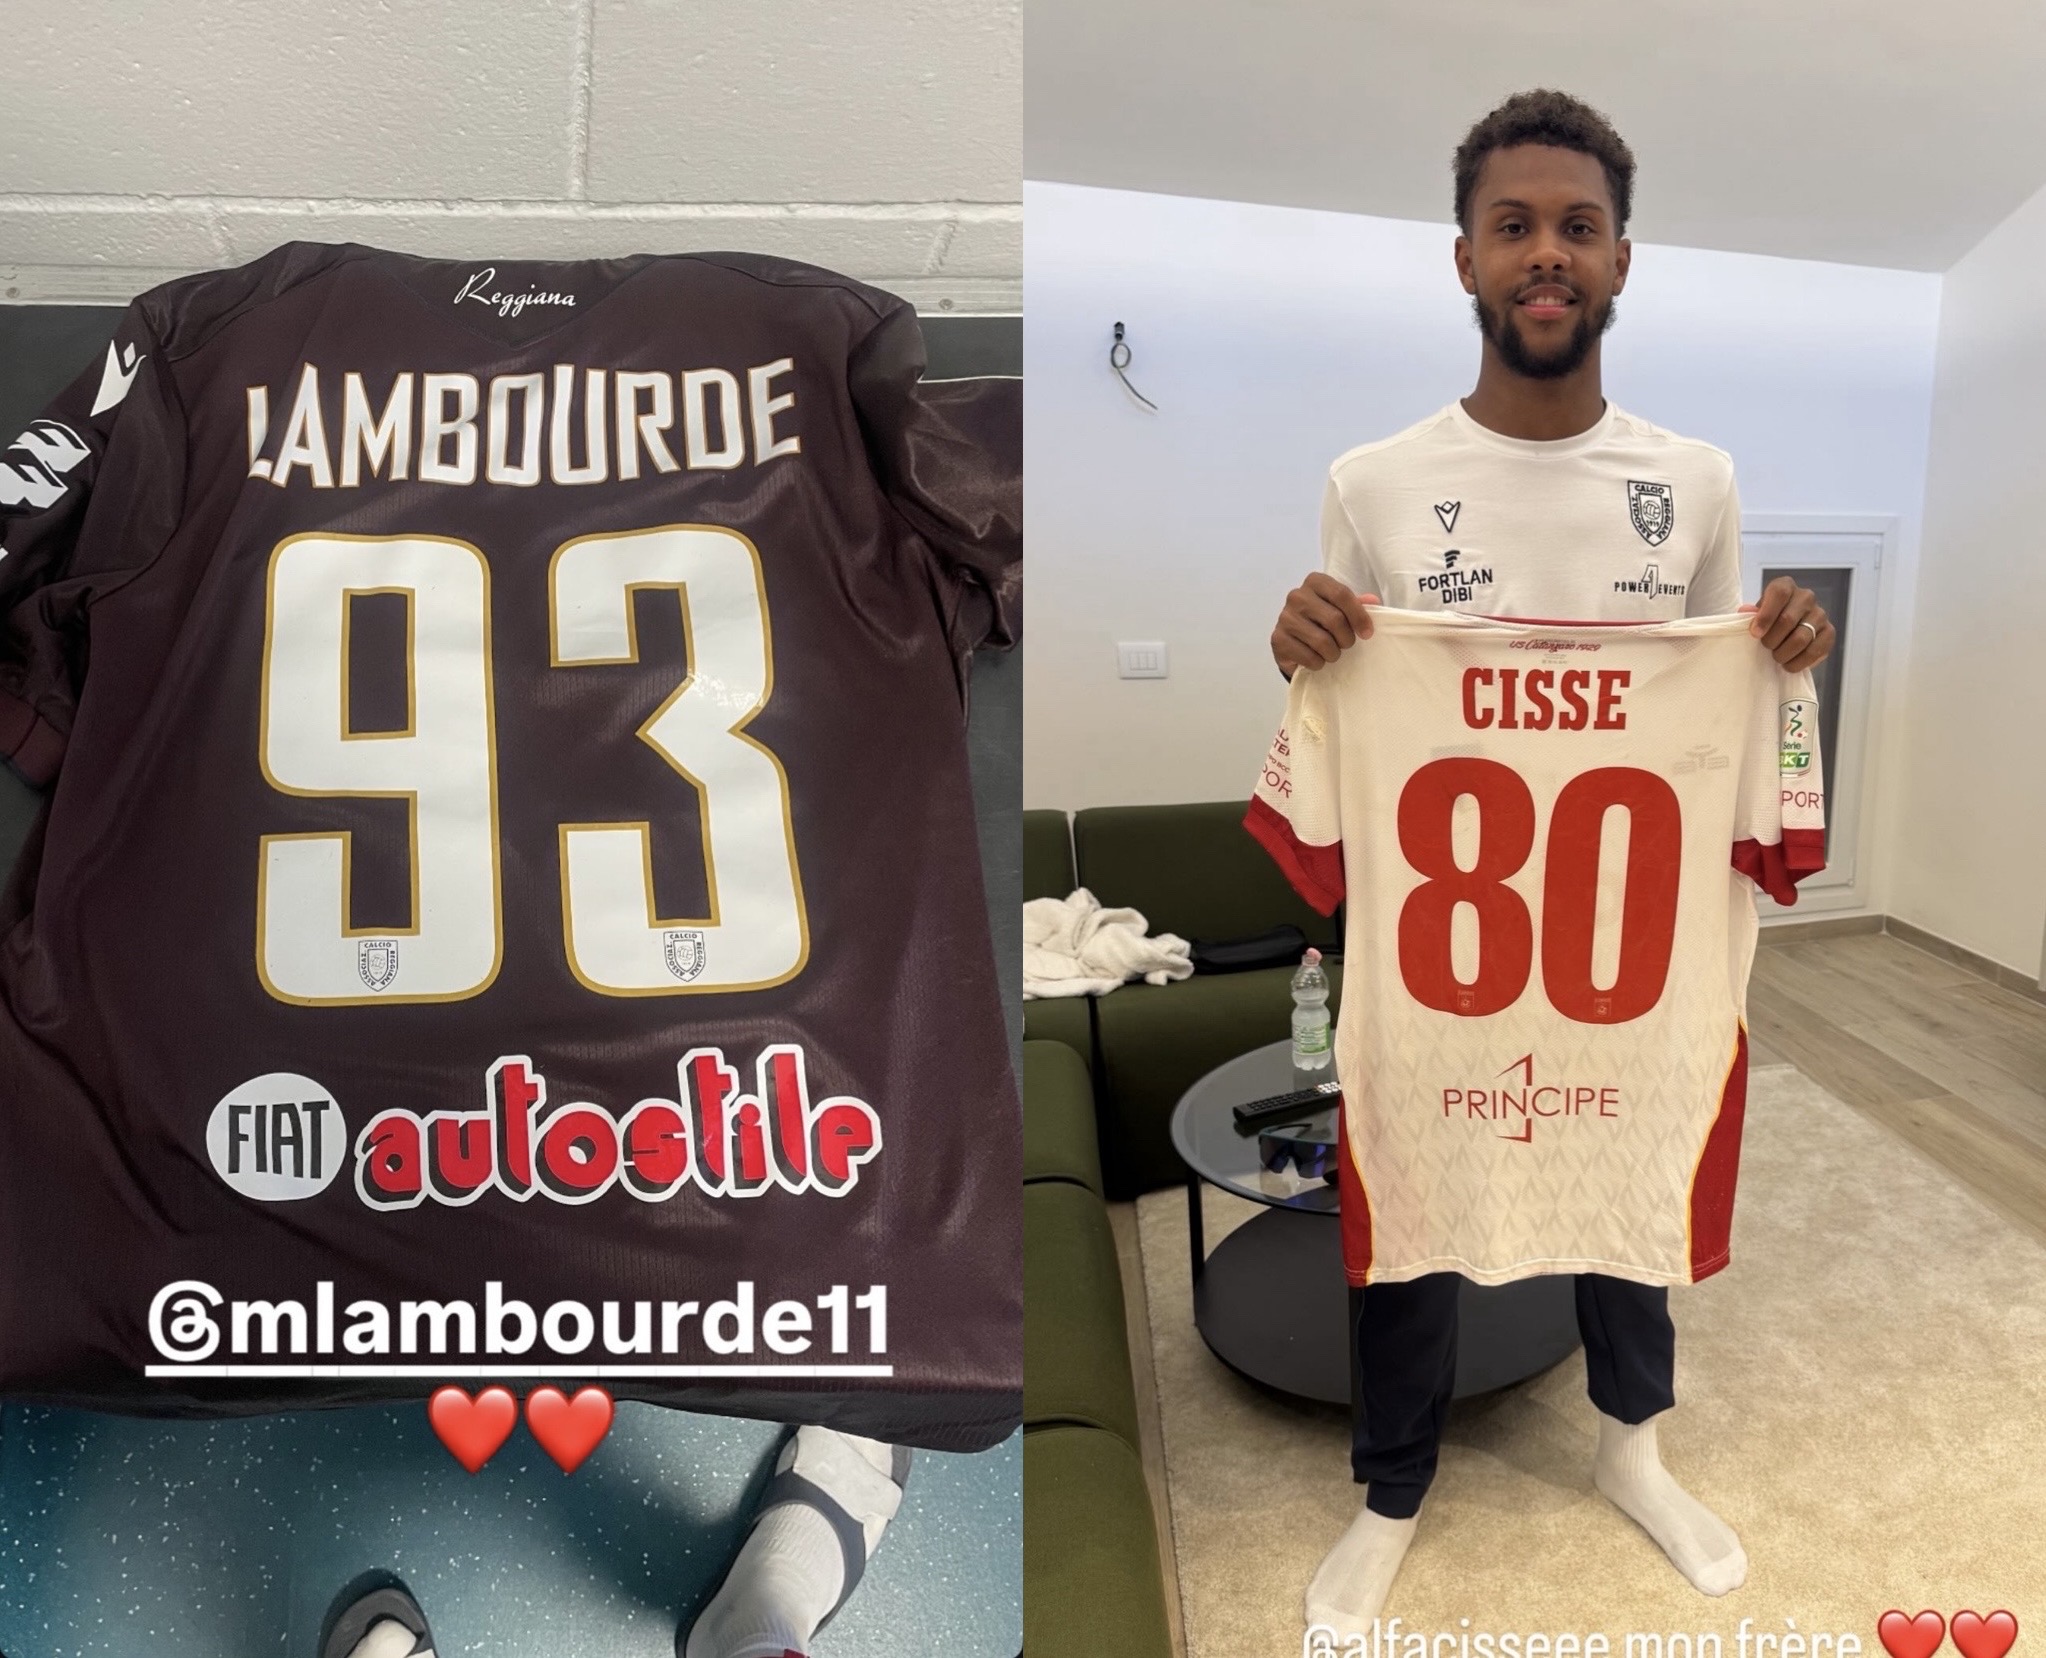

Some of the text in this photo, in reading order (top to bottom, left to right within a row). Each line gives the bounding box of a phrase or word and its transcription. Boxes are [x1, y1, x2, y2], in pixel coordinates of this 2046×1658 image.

[454, 267, 577, 318] Reggiana
[246, 357, 801, 488] LAMBOURDE
[1634, 484, 1665, 494] CALCIO
[1656, 497, 1672, 540] REGGIANA
[1418, 568, 1494, 593] FORTLAN
[1442, 586, 1473, 604] DIBI
[1614, 581, 1649, 594] POWER
[1658, 583, 1686, 596] EVENTS
[1509, 640, 1527, 650] US
[1462, 667, 1632, 732] CISSE
[1780, 752, 1811, 768] KT
[1783, 741, 1802, 750] Serie
[256, 523, 810, 1007] 93
[1397, 757, 1683, 1025] 80
[379, 950, 396, 986] REGGIANA
[689, 941, 704, 976] REGGIANA
[1443, 1086, 1620, 1120] PRINCIPE
[227, 1100, 331, 1180] FIAT
[360, 1048, 876, 1203] autostile
